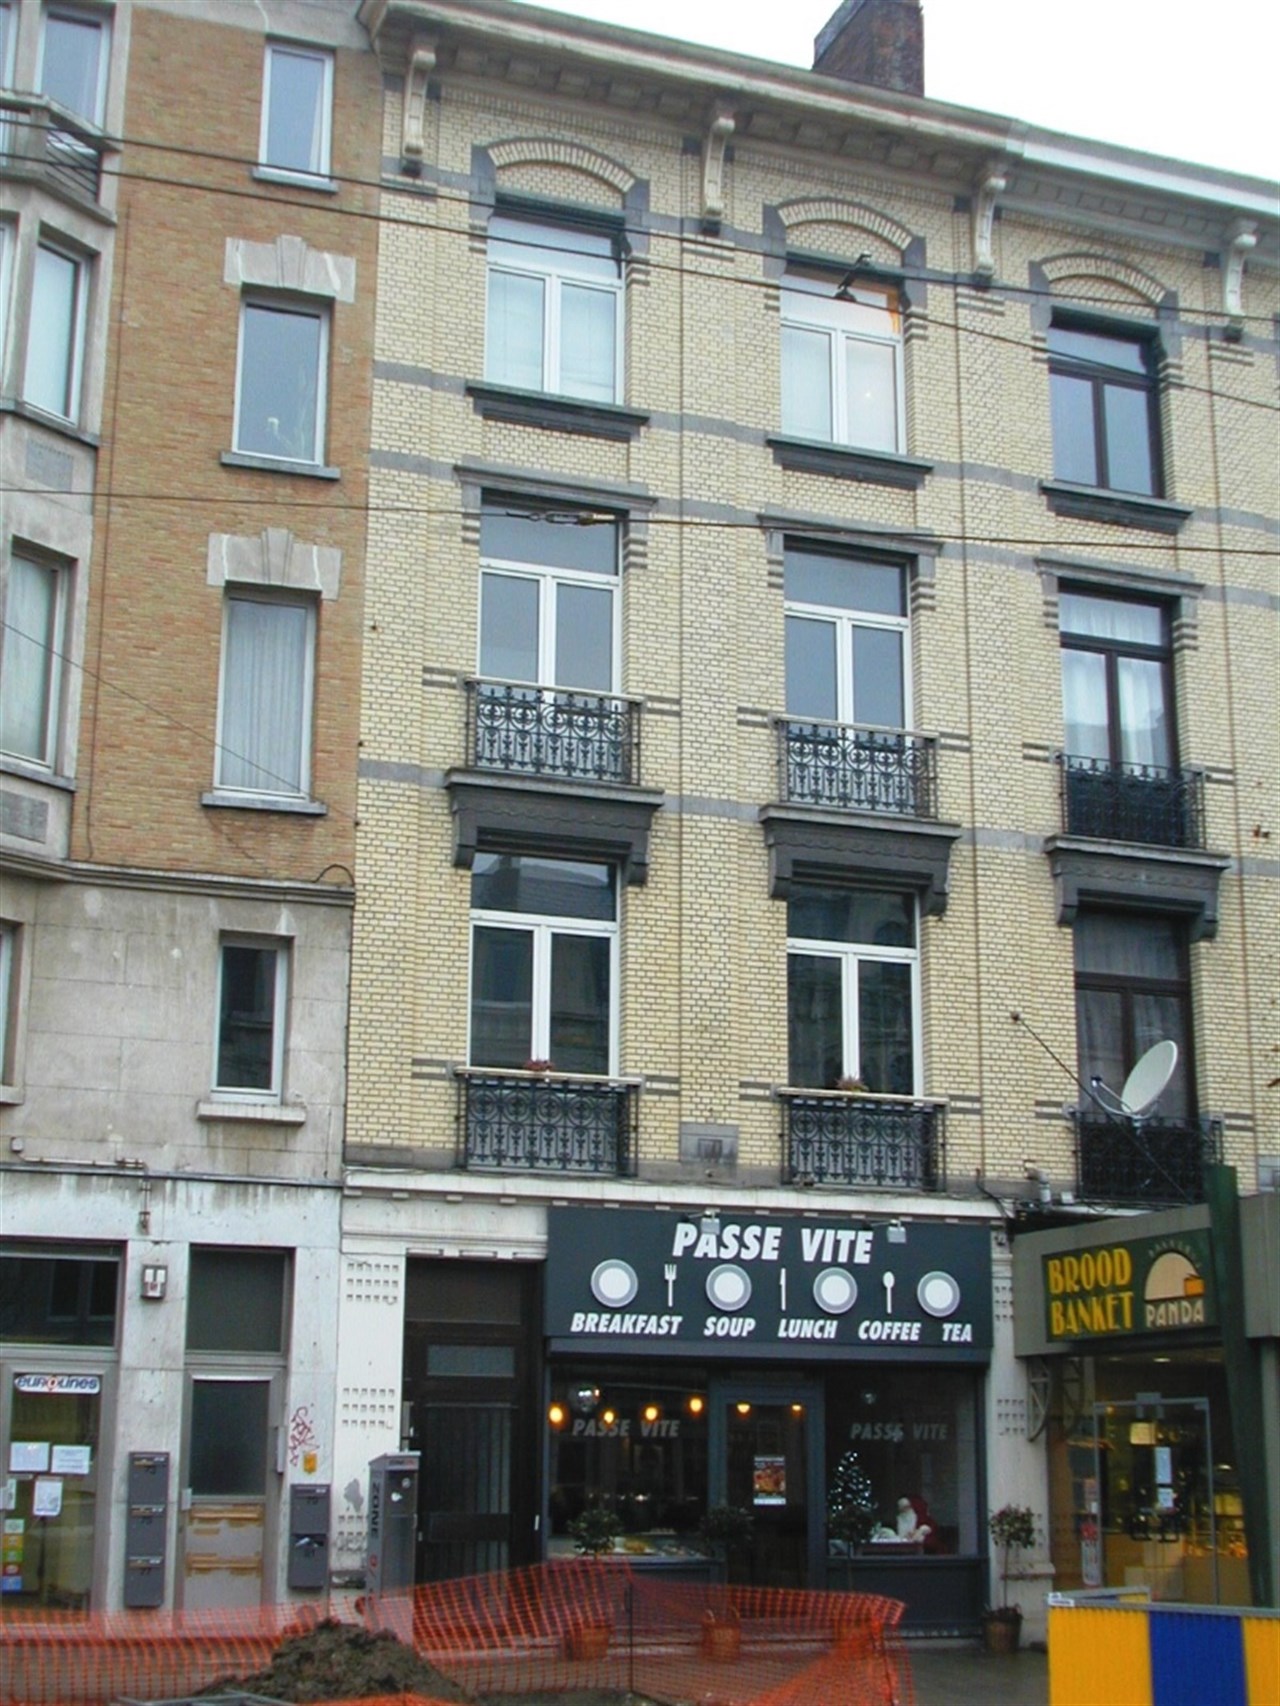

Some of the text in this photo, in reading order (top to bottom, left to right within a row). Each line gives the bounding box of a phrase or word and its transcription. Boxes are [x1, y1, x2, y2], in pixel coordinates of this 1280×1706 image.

[672, 1222, 874, 1264] PASSE VITE
[1047, 1246, 1133, 1295] BROOD
[570, 1312, 973, 1342] BREAKFAST SOUP LUNCH COFFEE TEA
[1050, 1290, 1135, 1336] BANKET
[1145, 1299, 1205, 1328] PANDA
[572, 1418, 680, 1437] PASSE VITE
[912, 1422, 949, 1440] VITE
